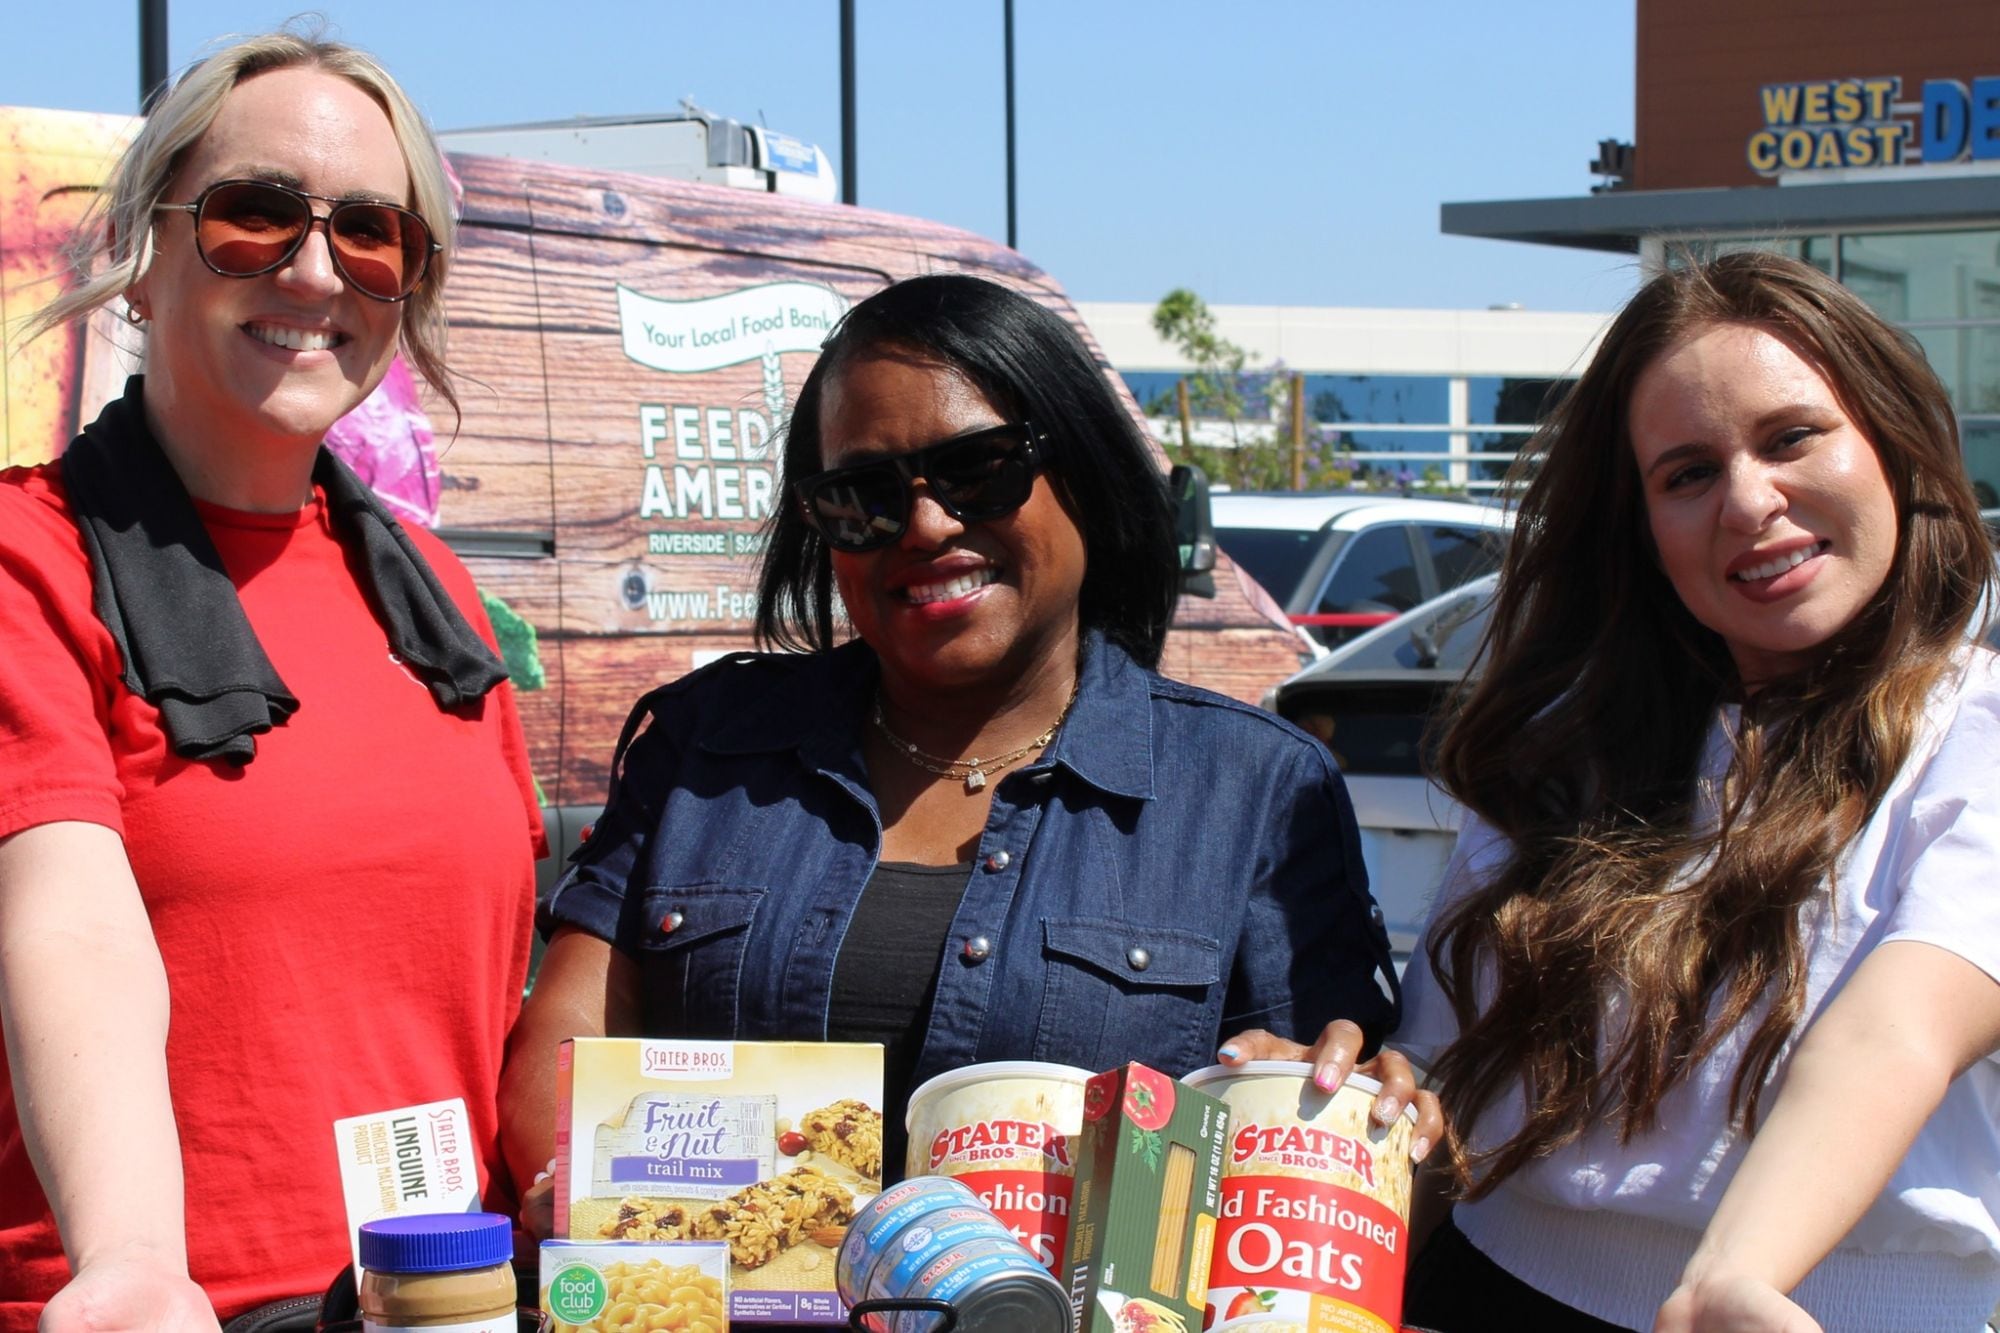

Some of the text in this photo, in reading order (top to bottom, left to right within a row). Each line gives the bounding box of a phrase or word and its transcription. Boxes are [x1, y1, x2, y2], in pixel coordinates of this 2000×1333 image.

[1760, 79, 1896, 125] WEST
[1748, 126, 1904, 171] COAST
[642, 306, 834, 349] Your Local Food Bank
[649, 532, 726, 554] RIVERSIDE
[644, 1047, 690, 1072] STATER
[428, 1108, 456, 1154] STATER
[644, 1100, 721, 1134] Fruit
[352, 1124, 373, 1166] PRODUCT
[392, 1116, 428, 1202] LINGUINE
[645, 1127, 727, 1160] & Nut
[930, 1120, 1072, 1169] STATER
[968, 1148, 1019, 1162] BROS.
[1233, 1123, 1376, 1188] STATER
[370, 1121, 399, 1213] ENRICHED MACARONI
[647, 1161, 724, 1179] trail mix
[1280, 1153, 1333, 1171] BROS.
[873, 1185, 921, 1214] STATER
[869, 1213, 899, 1245] Chunk
[899, 1199, 926, 1219] Light
[1256, 1189, 1398, 1255] Fashioned
[921, 1251, 968, 1286] STATER
[944, 1267, 970, 1288] Light
[970, 1257, 999, 1270] Tuna
[1227, 1222, 1363, 1291] Oats
[560, 1277, 596, 1294] food
[560, 1293, 594, 1309] club
[800, 1297, 812, 1311] 8g
